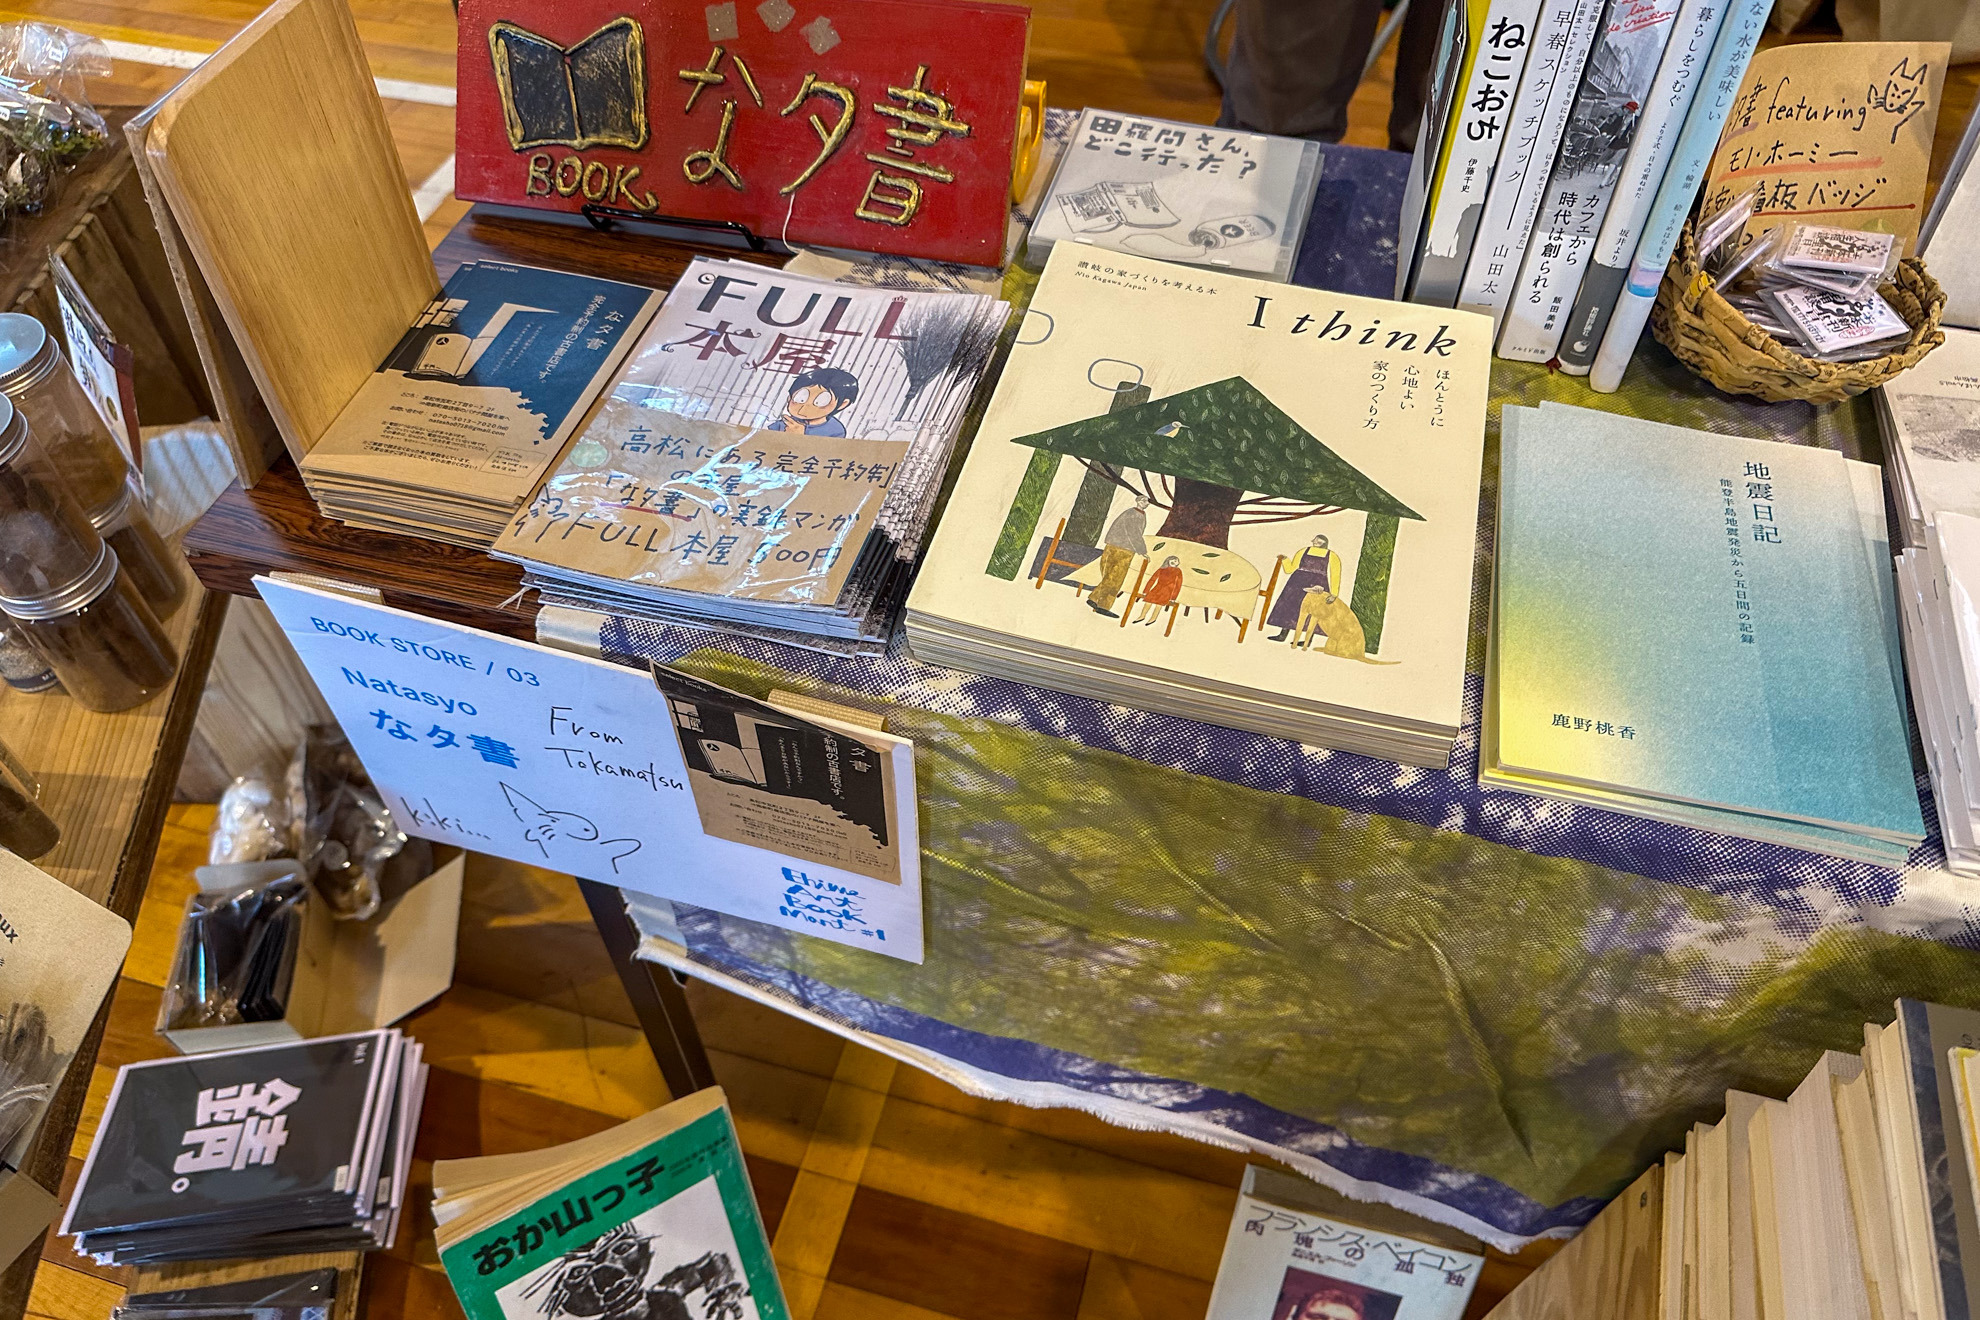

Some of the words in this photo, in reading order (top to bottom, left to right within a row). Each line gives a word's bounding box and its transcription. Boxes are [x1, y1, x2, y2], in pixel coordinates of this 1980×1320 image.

[1466, 17, 1526, 141] ねこおち
[1667, 7, 1716, 108] 暮らしをつむぐ
[1505, 10, 1571, 183] 早春スケッチブック
[1767, 77, 1867, 131] featuring
[526, 153, 660, 213] BOOK
[1529, 191, 1578, 304] 時代は創られる
[1566, 194, 1600, 266] カフェから
[1609, 229, 1631, 269] 坂井より
[697, 272, 919, 341] FULL
[1076, 261, 1218, 296] 讃岐の家づくりを考える本
[1123, 281, 1148, 292] Japan
[1477, 245, 1509, 307] 山田太一
[663, 320, 838, 374] 本屋
[1247, 296, 1273, 329] I
[1290, 310, 1458, 358] think
[1363, 360, 1389, 430] 家のつくり方
[1399, 365, 1420, 411] 心地よい
[1430, 369, 1451, 428] ほんとうに
[1743, 462, 1782, 545] 地震日記
[562, 512, 657, 553] FULL
[672, 532, 740, 567] 本屋
[1719, 478, 1755, 645] 能登半島地震発災から五日間の記録
[310, 616, 388, 647] BOOK
[389, 637, 476, 671] STORE
[506, 667, 541, 687] 03
[341, 667, 478, 717] Natasyo
[548, 706, 624, 745] From
[1551, 713, 1636, 741] 鹿野桃香
[824, 736, 845, 800] 約制の古書店です。
[783, 893, 867, 925] Book
[1250, 1205, 1471, 1272] フランシス・ベイコン
